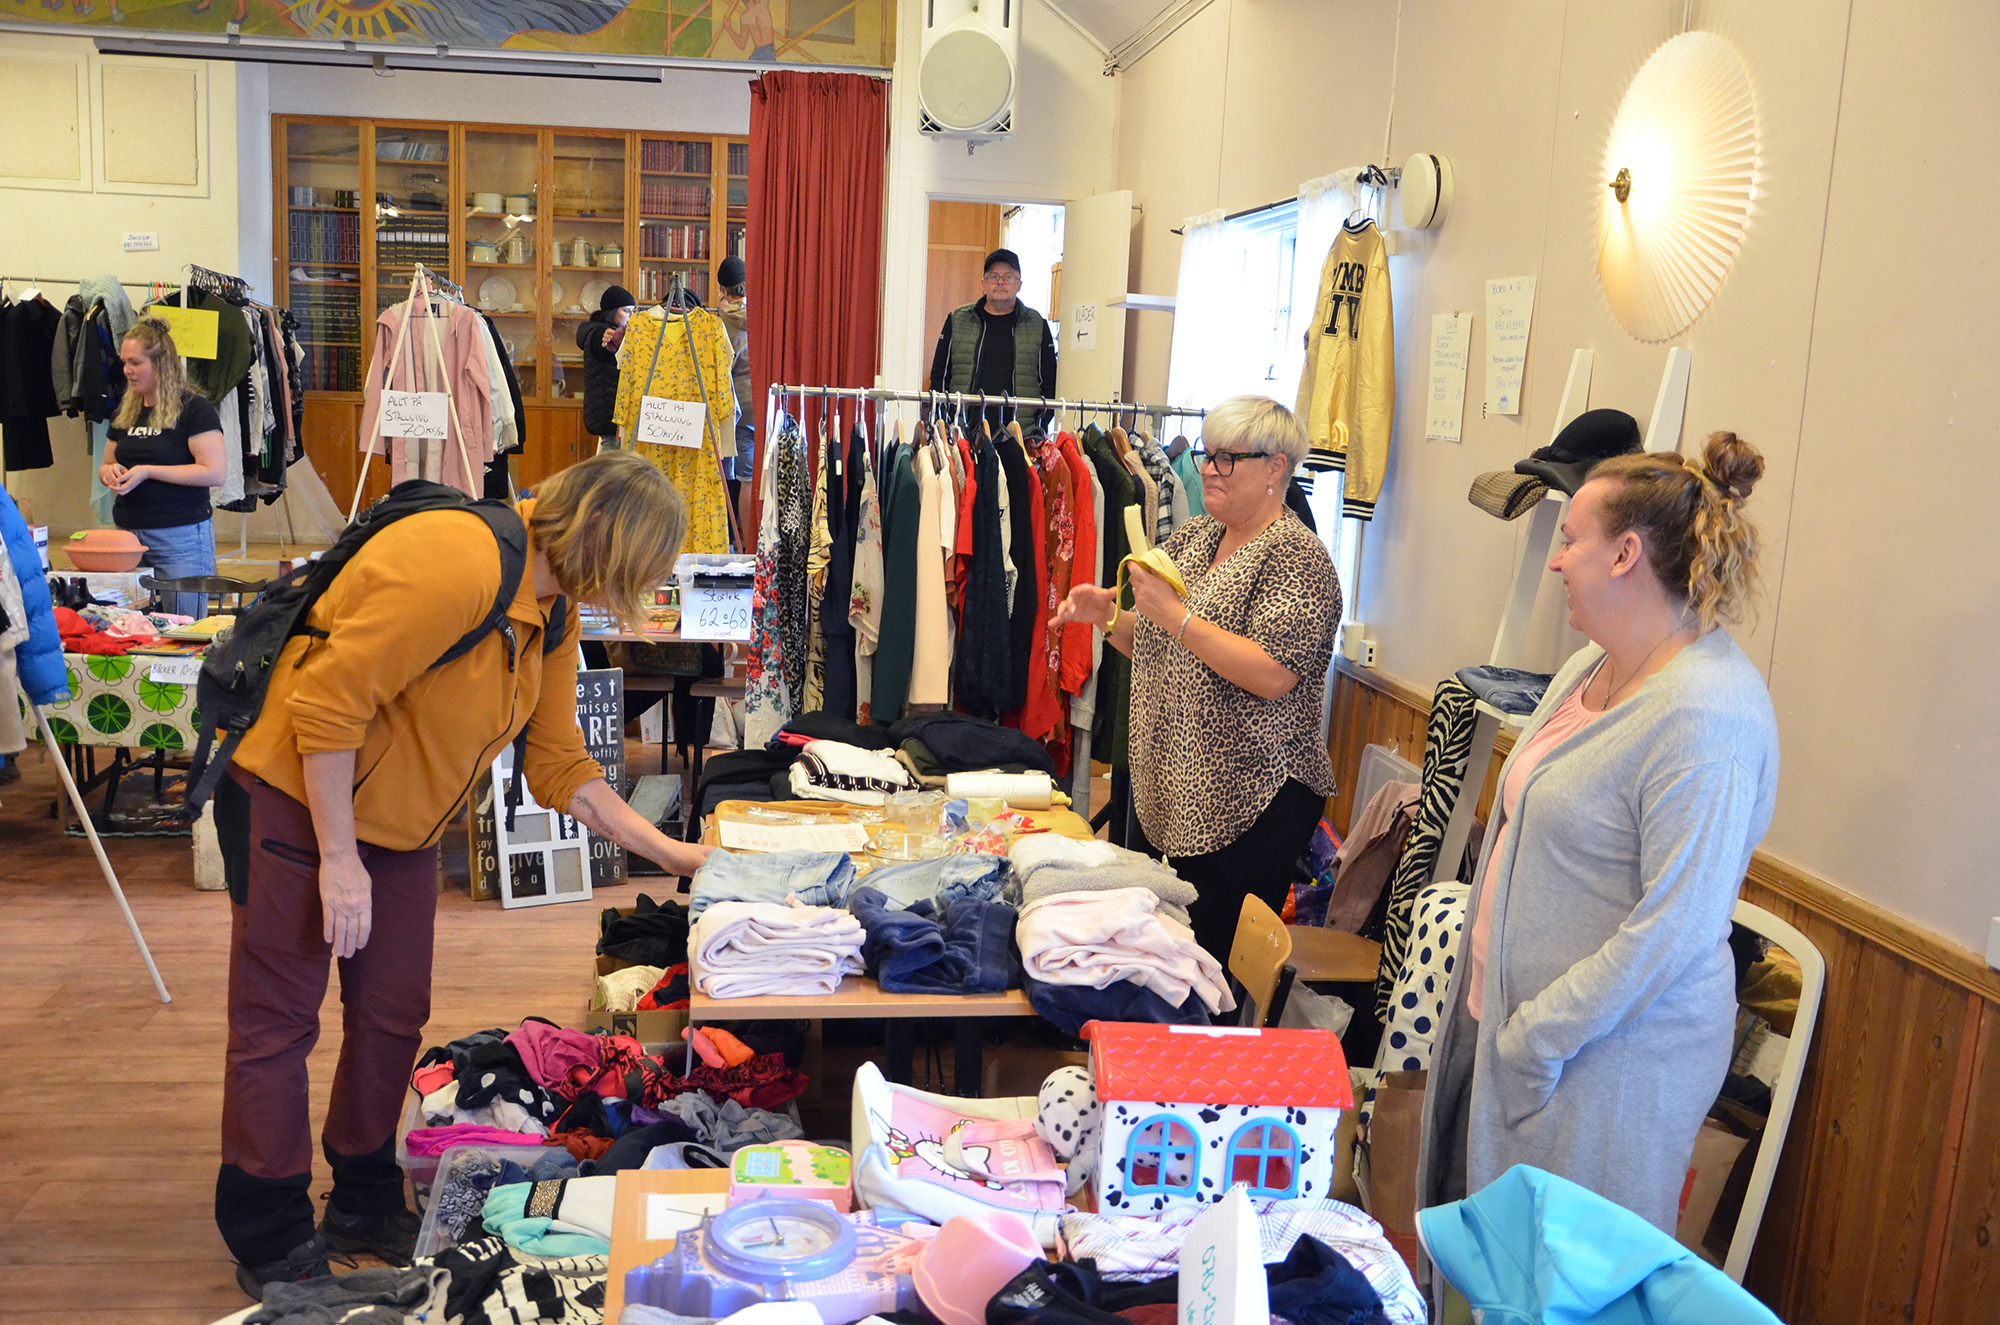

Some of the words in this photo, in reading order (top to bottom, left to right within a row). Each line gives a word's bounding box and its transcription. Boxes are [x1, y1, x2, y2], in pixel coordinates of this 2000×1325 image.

[387, 395, 408, 407] ALLT
[646, 402, 668, 410] ALLT
[644, 411, 692, 426] STÄLLNING
[646, 423, 684, 442] 50kr/st
[699, 607, 720, 627] 62
[729, 606, 748, 629] 68
[576, 679, 616, 698] est
[577, 700, 618, 714] mises
[589, 747, 618, 759] softly
[476, 840, 493, 851] say
